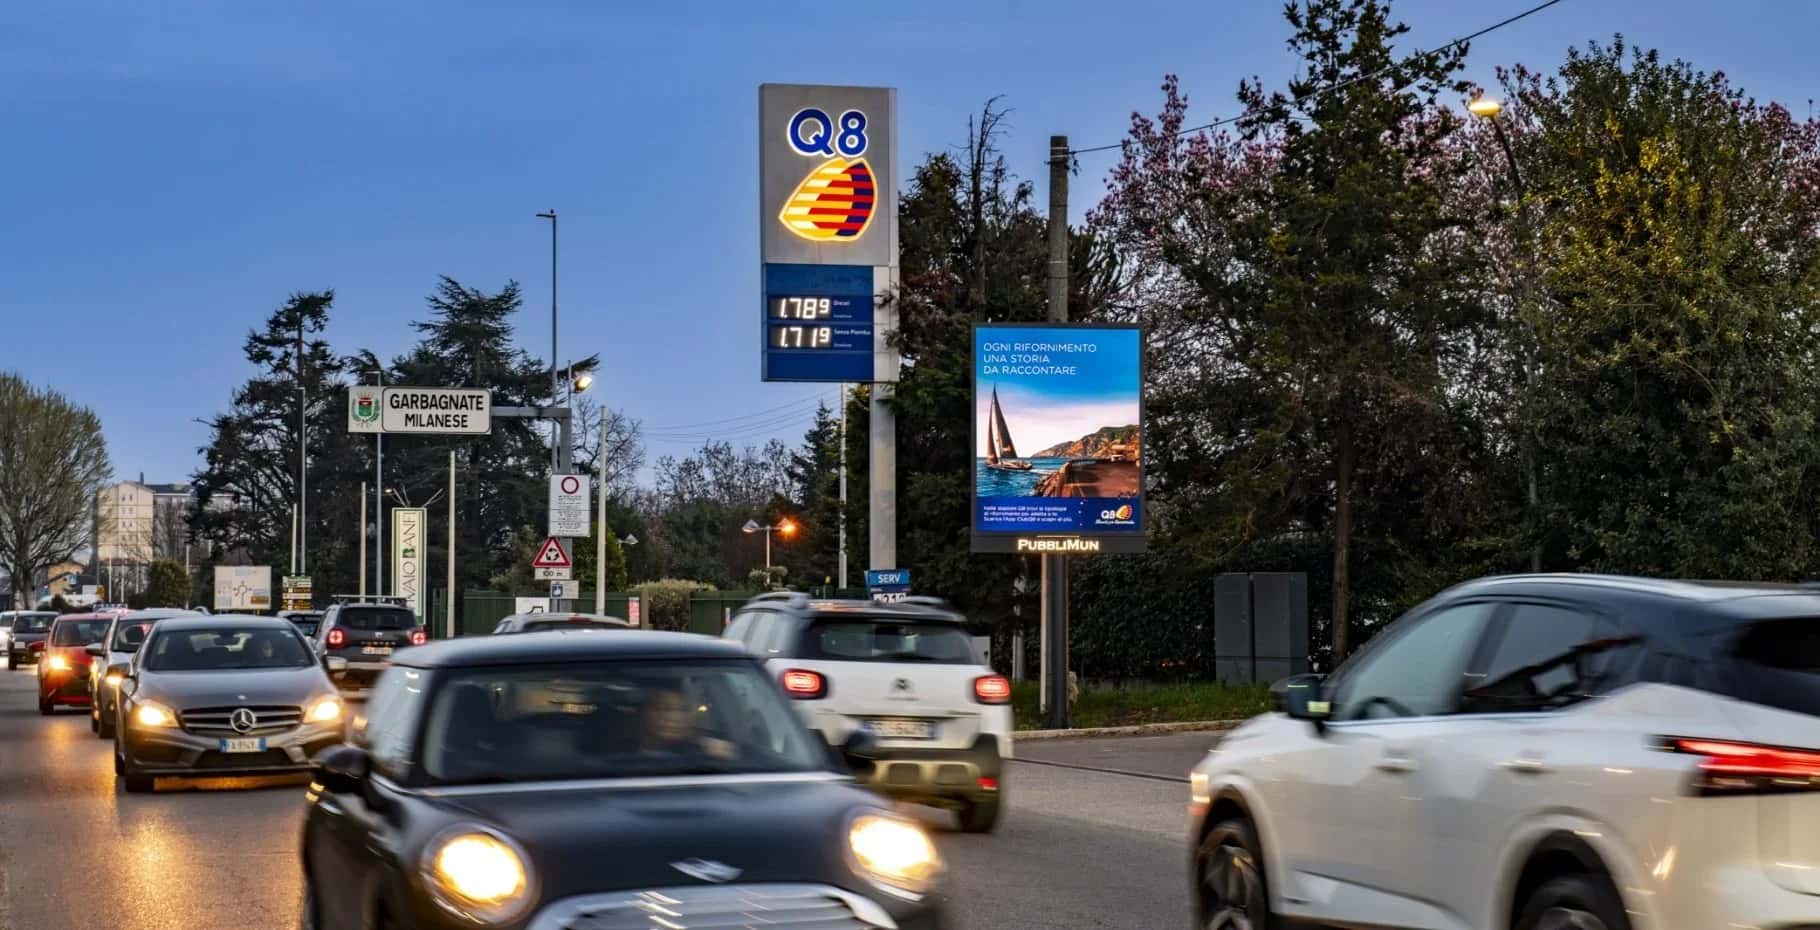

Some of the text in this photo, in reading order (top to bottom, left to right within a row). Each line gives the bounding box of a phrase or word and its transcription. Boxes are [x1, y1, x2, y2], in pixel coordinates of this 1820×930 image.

[787, 107, 868, 158] Q8
[983, 342, 1097, 353] OGNI RIFORNIMENTO
[983, 354, 1051, 363] UNA STORIA
[983, 365, 1077, 375] DA RACCONTARE
[390, 393, 484, 411] GARBAGNATE
[404, 413, 468, 428] MILANESE
[878, 573, 900, 584] SERV
